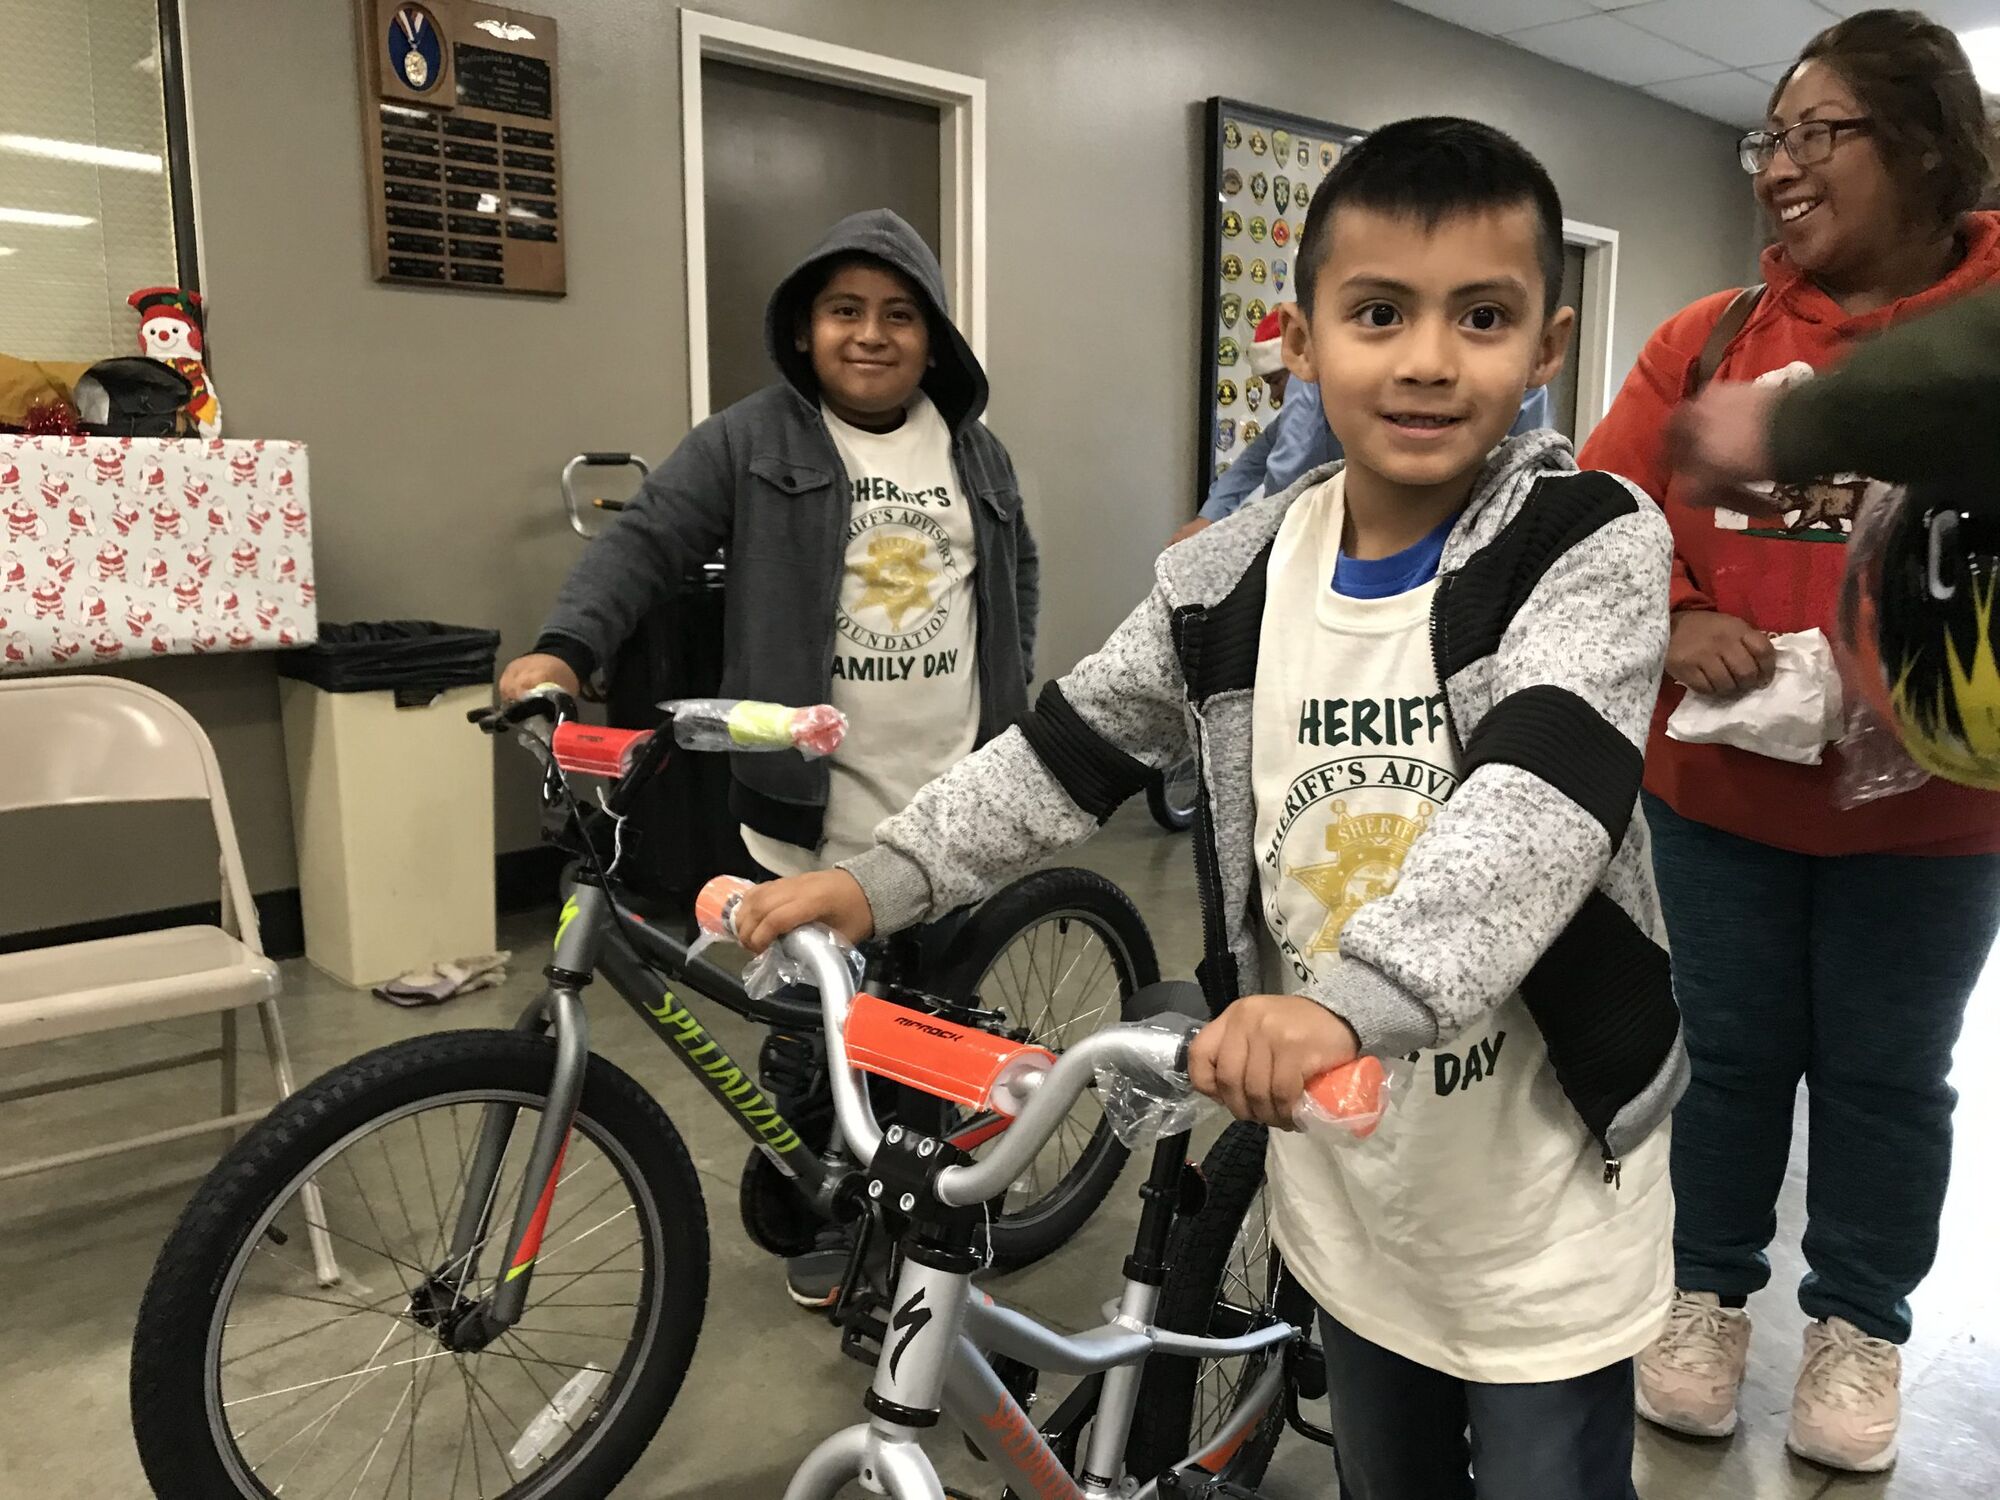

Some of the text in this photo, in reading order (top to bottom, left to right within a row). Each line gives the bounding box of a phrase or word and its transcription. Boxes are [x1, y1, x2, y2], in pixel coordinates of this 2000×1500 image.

[899, 510, 956, 569] ADVISORY
[836, 604, 948, 650] OUNDATION
[832, 648, 958, 681] AMILY DAY
[1298, 695, 1446, 747] HERIFF
[1265, 761, 1457, 869] SHERIFF'S ADVI
[894, 1017, 964, 1042] RIPROCK
[642, 991, 801, 1153] SPECIALIZED
[1435, 1031, 1507, 1097] DAY
